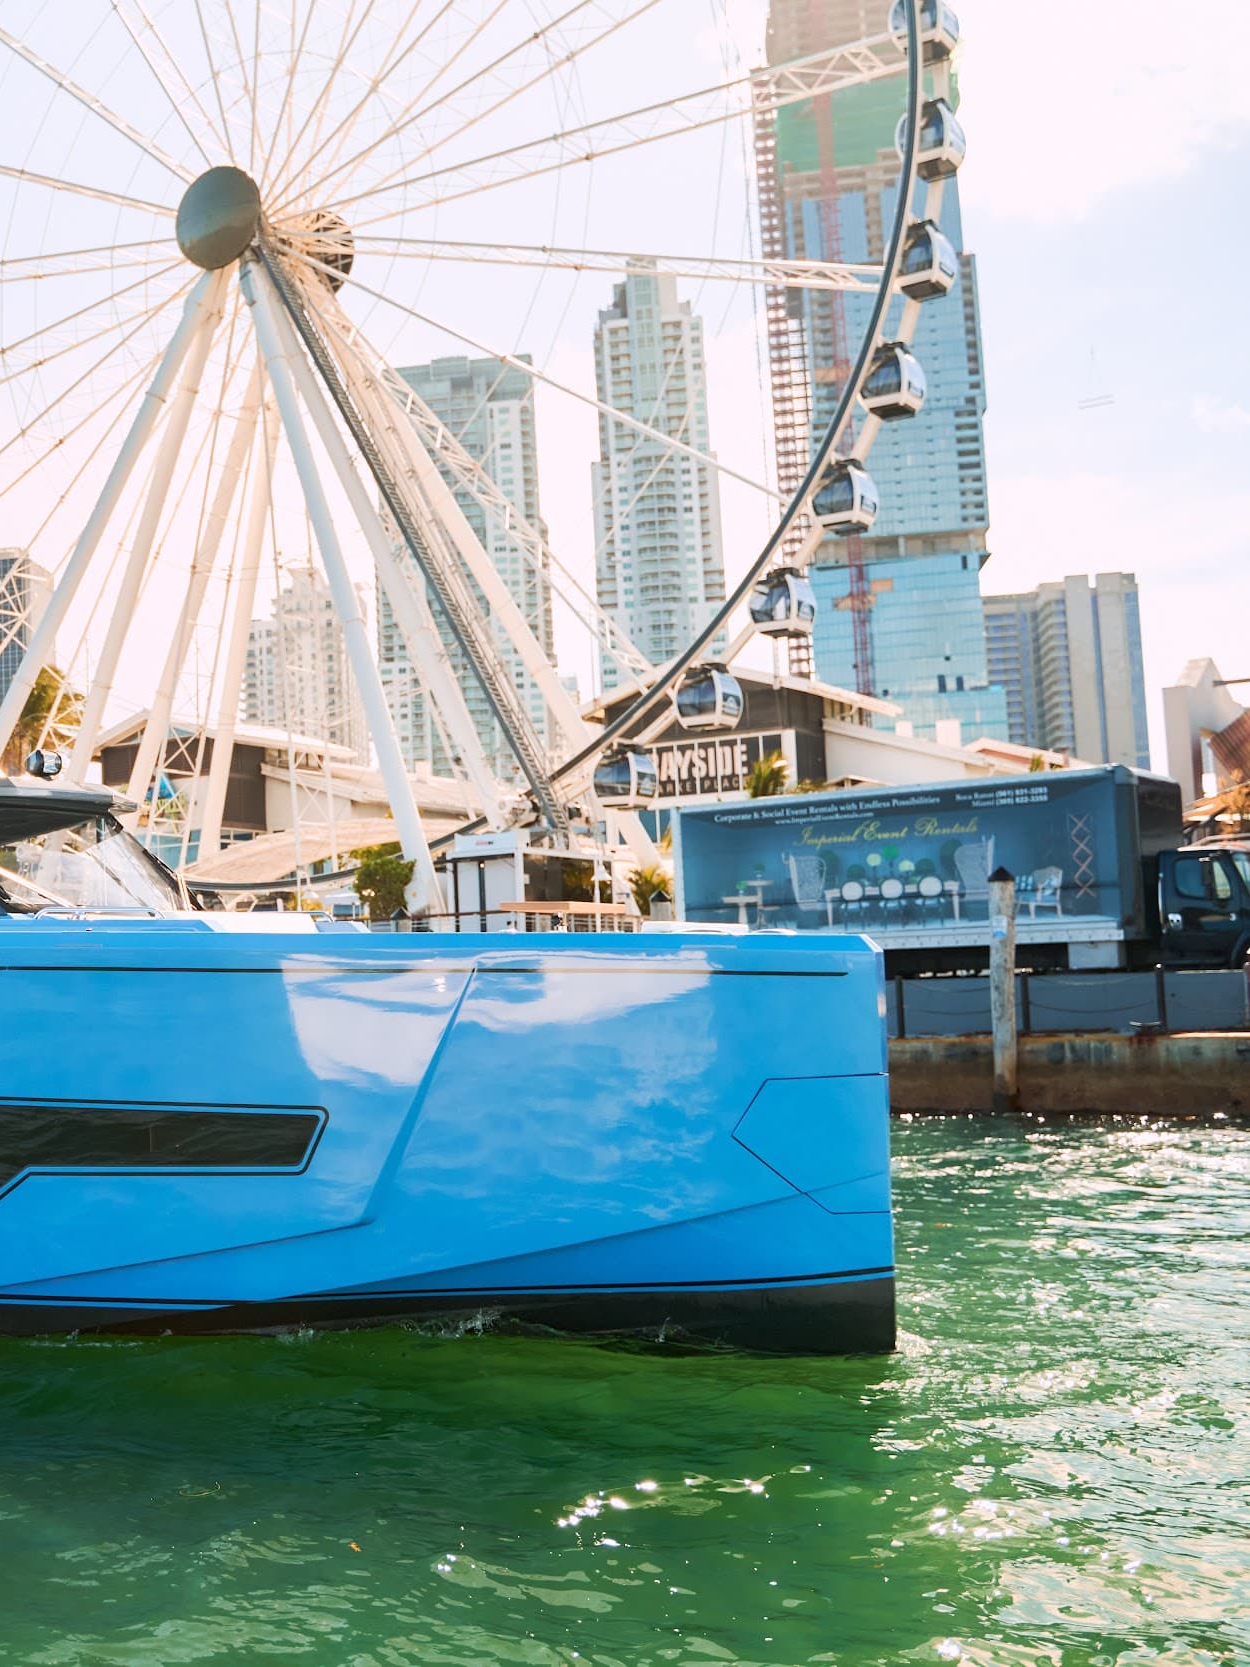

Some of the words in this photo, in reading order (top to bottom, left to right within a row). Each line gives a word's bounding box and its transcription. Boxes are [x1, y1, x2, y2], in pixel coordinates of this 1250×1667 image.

[713, 813, 752, 824] Corporate
[761, 808, 785, 818] Social
[785, 807, 808, 817] Event
[809, 804, 838, 815] Rentals
[839, 802, 858, 812] with
[859, 800, 891, 810] Endless
[892, 796, 941, 808] Possibilities
[793, 824, 862, 848] Imperial
[861, 820, 908, 841] Event
[914, 816, 978, 836] Rentals
